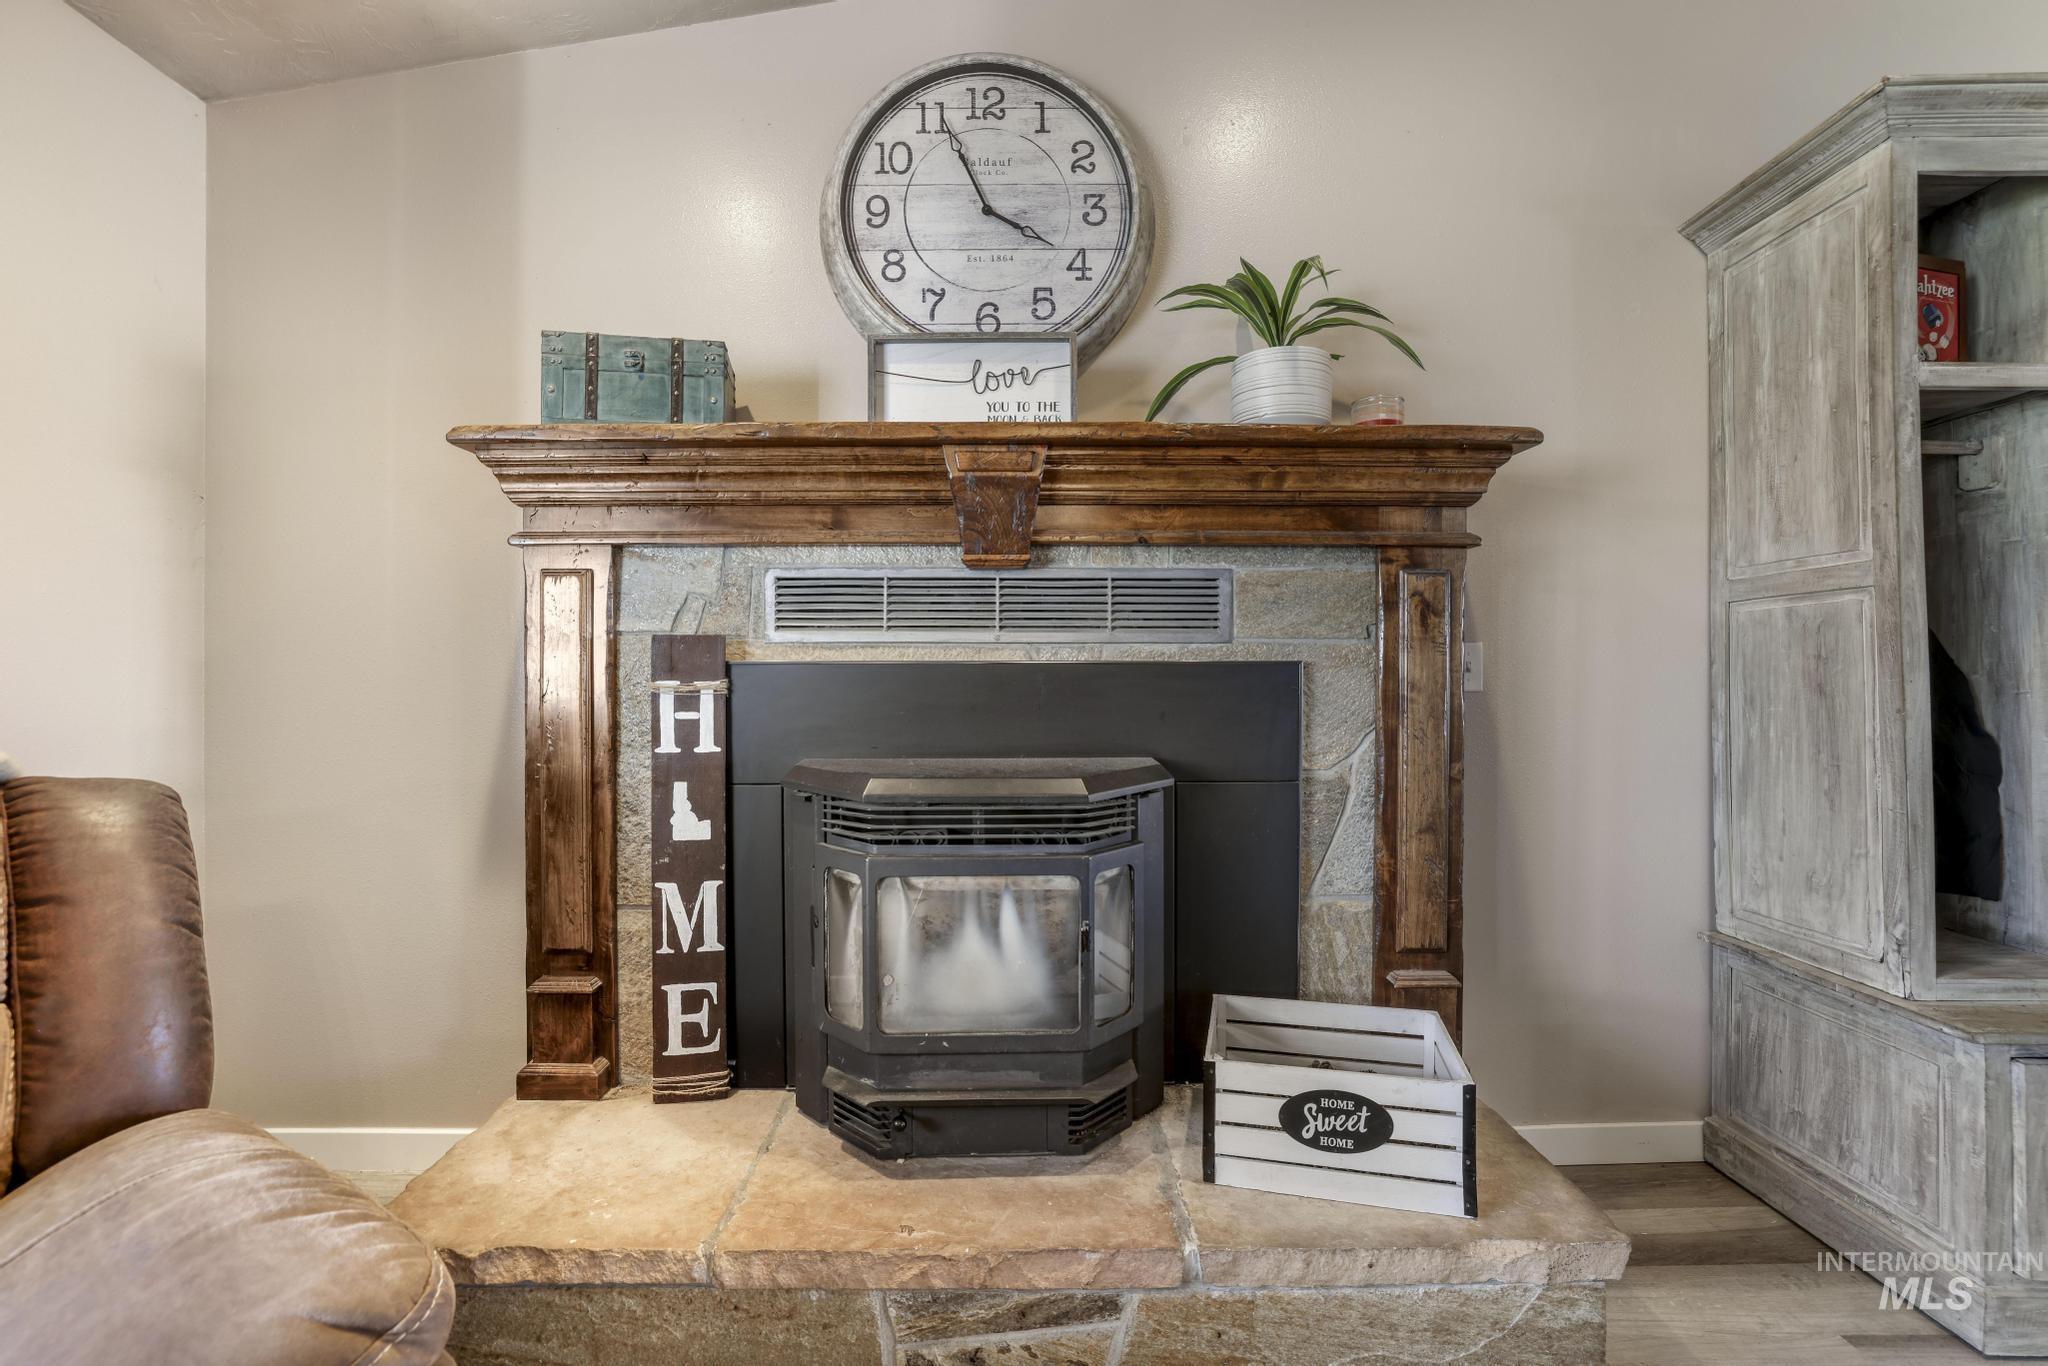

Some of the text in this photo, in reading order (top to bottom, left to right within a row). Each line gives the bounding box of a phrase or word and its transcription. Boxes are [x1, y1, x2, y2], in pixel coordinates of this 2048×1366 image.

[916, 101, 951, 134] 11
[966, 86, 1006, 120] 12
[1034, 101, 1051, 133] 1
[874, 141, 913, 175] 10
[963, 157, 1013, 167] aldauf
[1071, 140, 1096, 174] 2
[865, 194, 890, 229] 9
[1081, 193, 1107, 226] 3
[881, 248, 906, 283] 8
[966, 254, 1014, 263] Est. 1864
[1066, 248, 1093, 281] 4
[1918, 274, 1955, 299] ahtzee
[921, 287, 946, 321] 7
[975, 302, 1001, 333] 6
[1031, 287, 1057, 321] 5
[970, 359, 1040, 394] love
[986, 401, 1061, 413] YOU TO THE
[1301, 1102, 1371, 1139] Sweet
[1320, 1097, 1355, 1111] HOME
[1319, 1136, 1354, 1149] HOME
